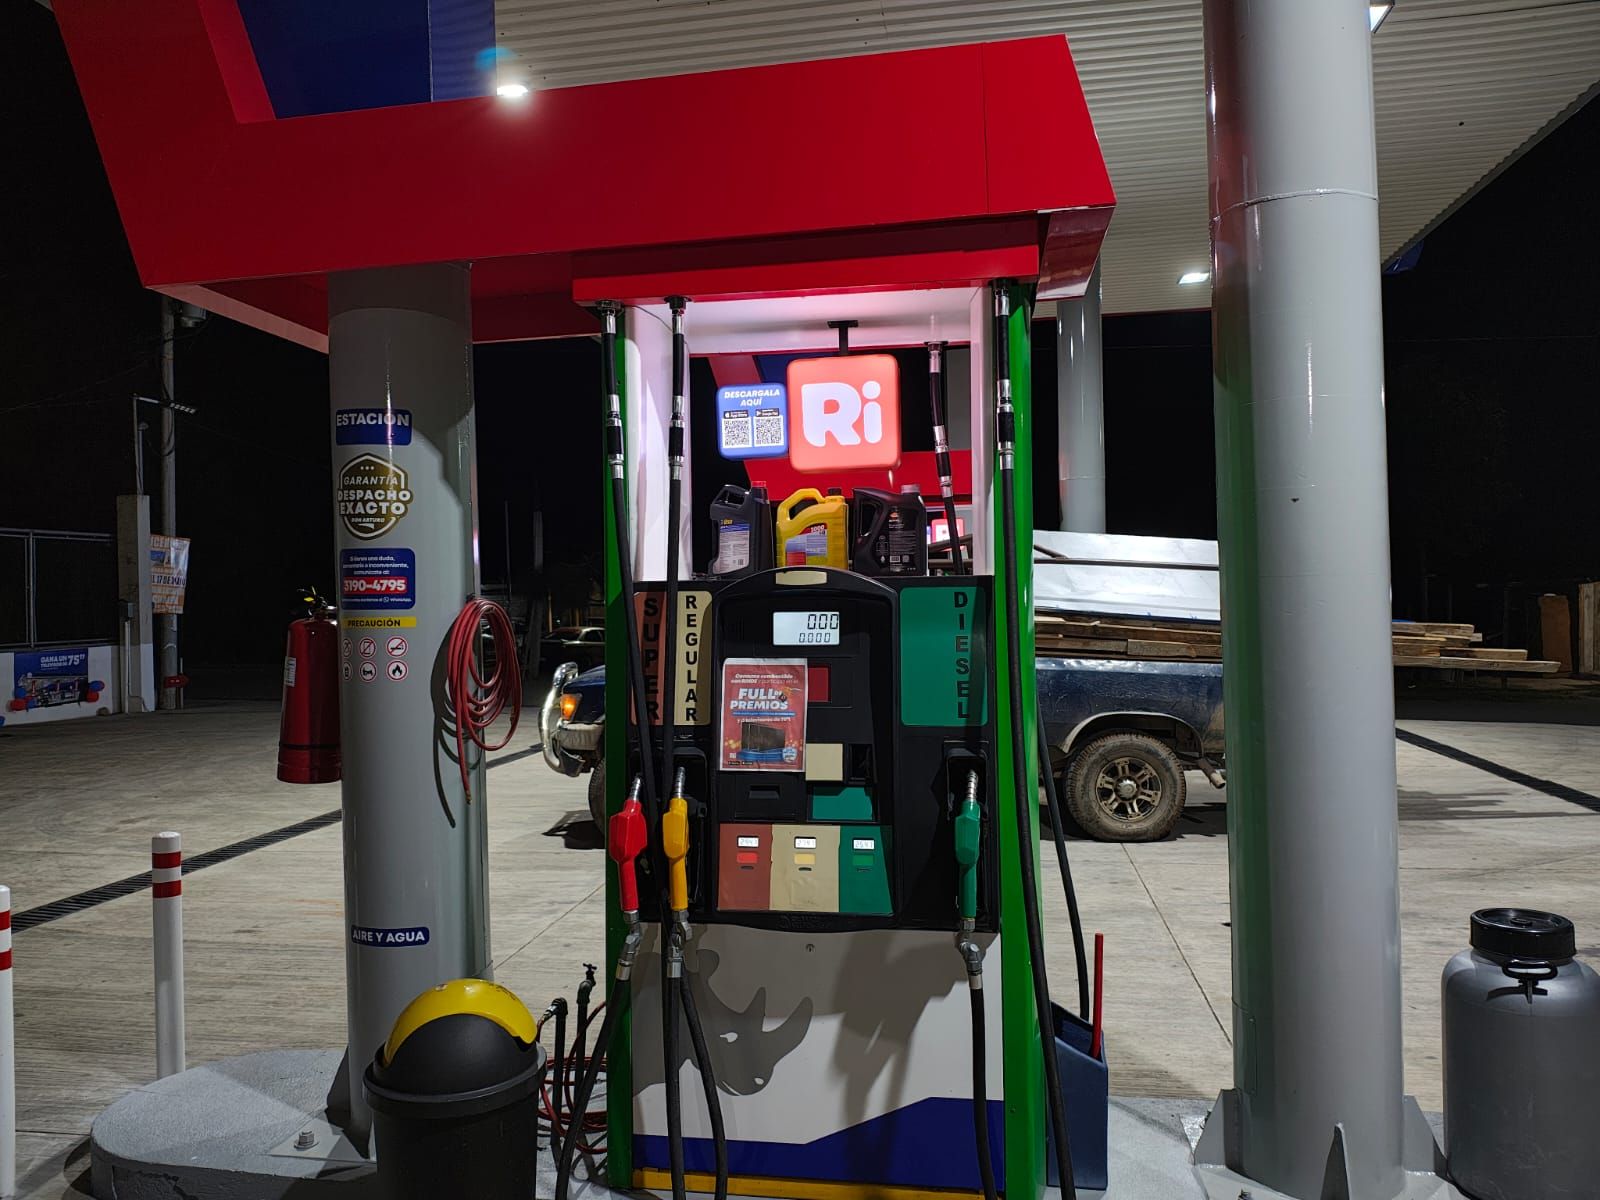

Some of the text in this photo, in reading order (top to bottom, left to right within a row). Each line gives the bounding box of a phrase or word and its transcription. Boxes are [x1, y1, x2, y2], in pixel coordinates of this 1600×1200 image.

[801, 381, 882, 447] Ri
[338, 489, 411, 502] DESPACHO
[340, 501, 406, 515] EXACTO
[344, 579, 407, 592] 3190-4795
[347, 618, 401, 627] PRECAUCIÓN
[643, 598, 659, 720] SUPER
[685, 595, 698, 721] REGULAR
[954, 591, 970, 719] DIESEL
[739, 687, 776, 700] FULL
[730, 700, 789, 710] PREMIOS
[353, 930, 425, 943] AIRE Y AGUA
